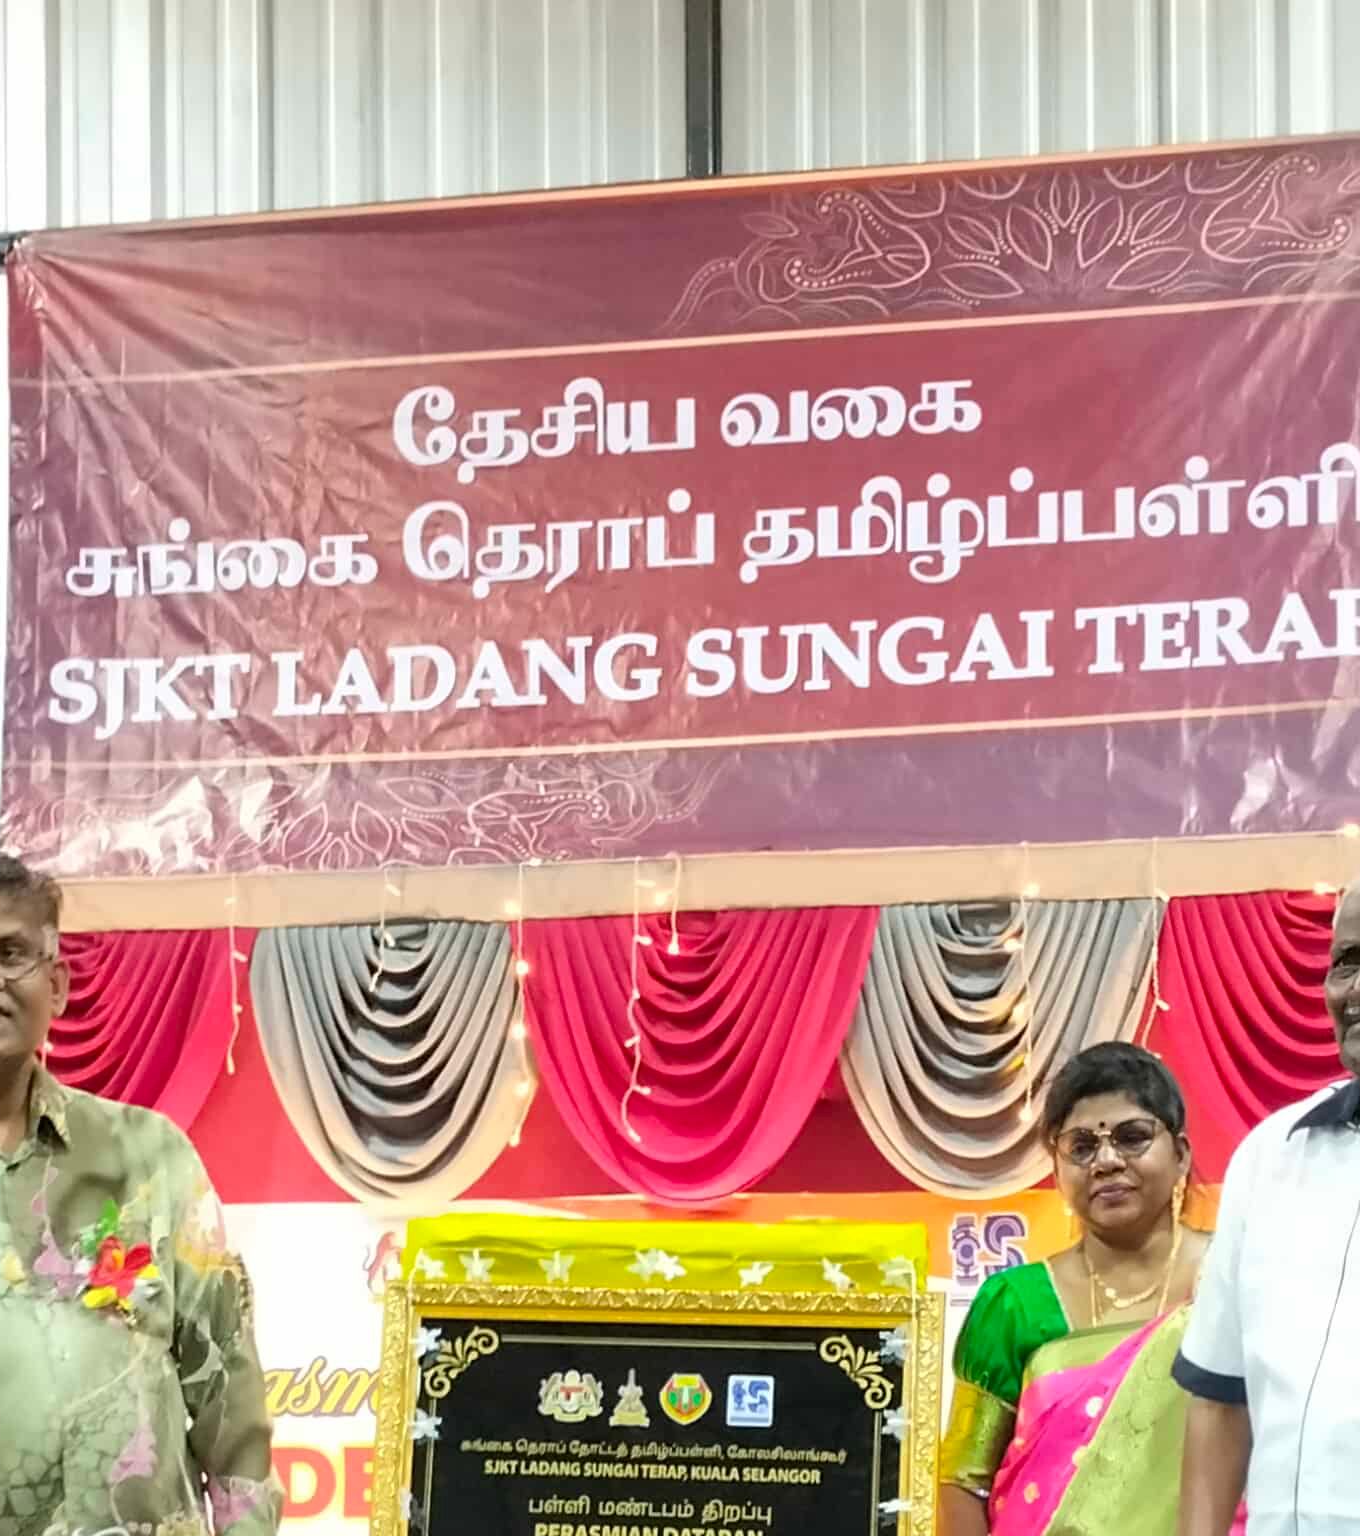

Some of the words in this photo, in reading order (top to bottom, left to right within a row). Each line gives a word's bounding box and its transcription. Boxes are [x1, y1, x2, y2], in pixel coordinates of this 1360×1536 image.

[393, 377, 696, 484] தேசிய
[720, 379, 982, 447] வகை
[401, 488, 715, 599] தெராப்
[47, 652, 251, 740] SJKT
[271, 634, 663, 721] LADANG
[685, 609, 1054, 700] SUNGAI
[484, 1459, 518, 1475] SJKT
[520, 1460, 581, 1477] LADANG
[583, 1461, 639, 1478] SUNGAI
[691, 1464, 740, 1481] KUALA
[742, 1466, 821, 1485] SELANGOR
